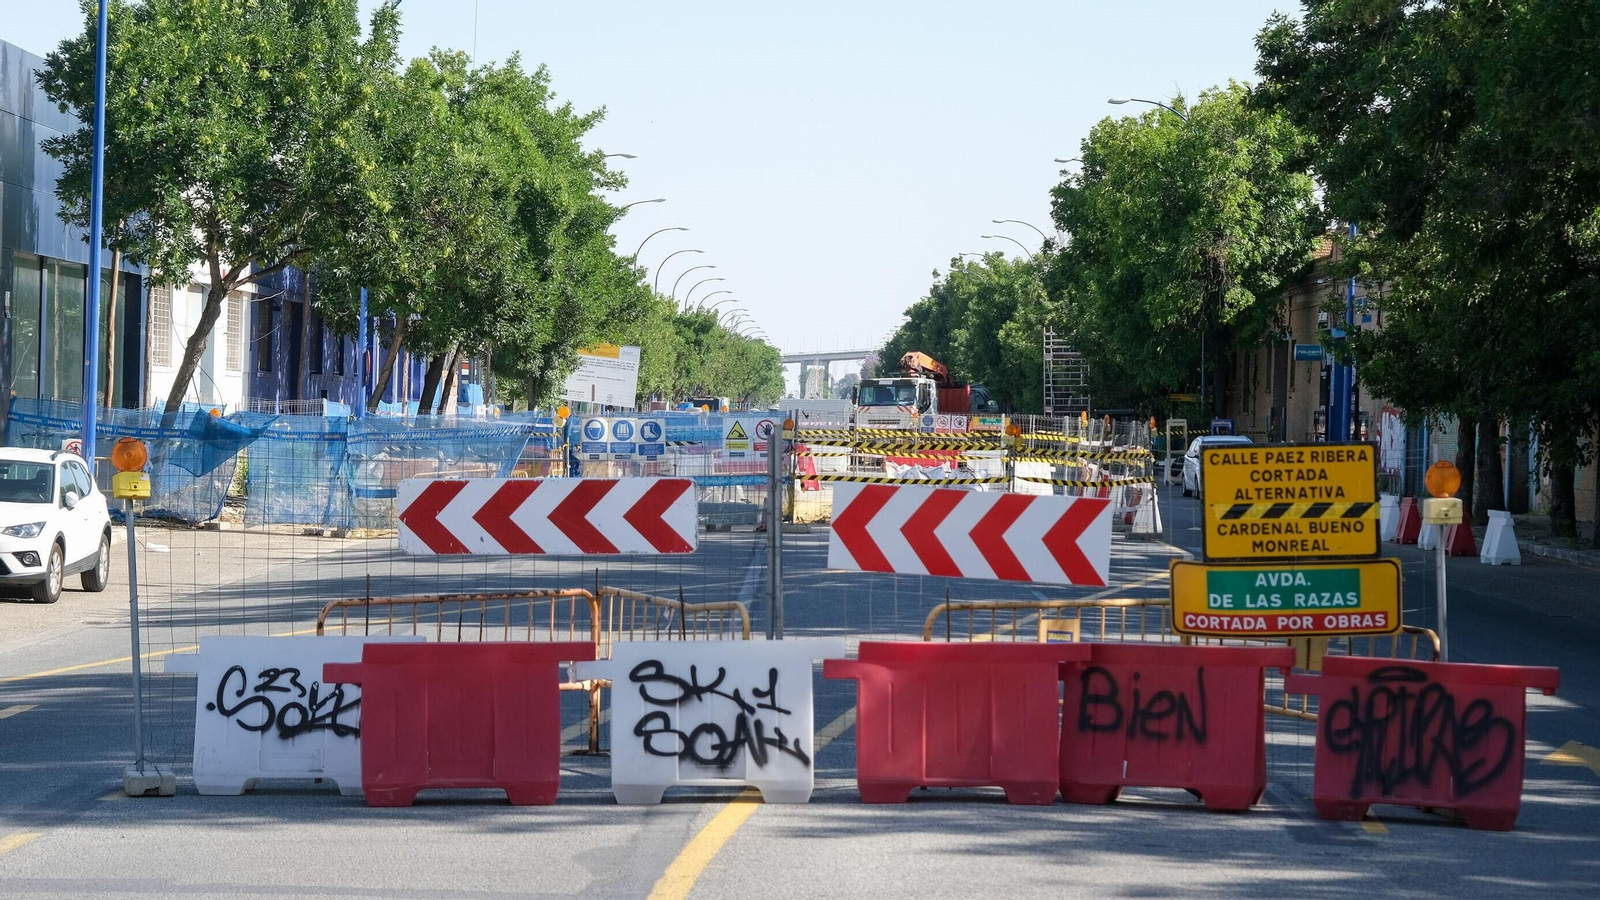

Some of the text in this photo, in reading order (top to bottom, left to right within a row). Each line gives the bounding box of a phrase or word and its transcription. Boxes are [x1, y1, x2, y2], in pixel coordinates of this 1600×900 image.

[1209, 449, 1368, 466] CALLE PAEZ RIBERA
[1250, 468, 1329, 483] CORTADA
[1234, 485, 1345, 501] ALTERNATIVA
[1217, 520, 1365, 536] CARDENAL BUENO
[1252, 539, 1330, 553] MONREAL
[1255, 572, 1311, 587] AVDA.
[1208, 592, 1359, 608] DE LAS RAZAS
[1184, 613, 1386, 630] CORTADA POR OBRAS
